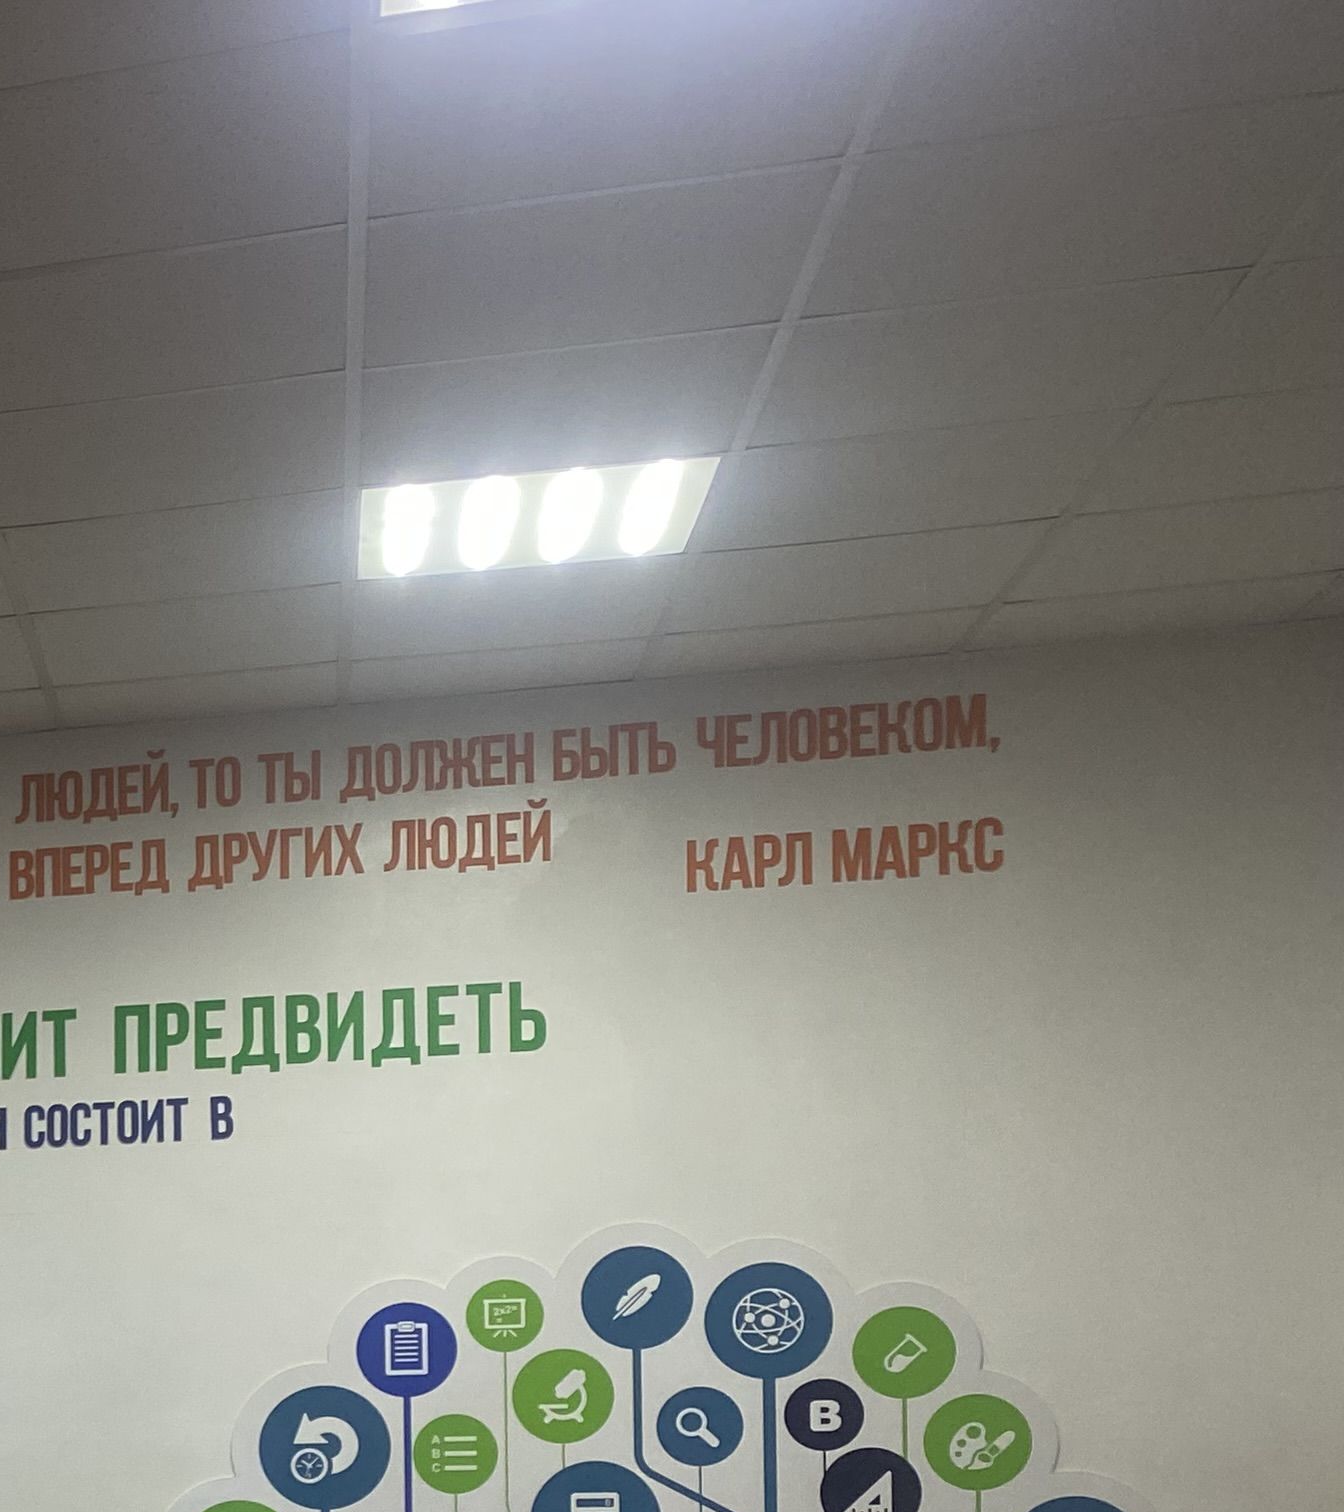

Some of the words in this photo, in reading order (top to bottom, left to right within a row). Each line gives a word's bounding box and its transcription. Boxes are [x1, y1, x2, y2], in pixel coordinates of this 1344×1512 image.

[14, 749, 180, 825] ЛЮДЕЙ,
[189, 756, 243, 809] ТО
[257, 750, 321, 805] ТЫ
[340, 731, 535, 804] ДОЛЖЕН
[552, 720, 677, 782] БЫТЬ
[696, 693, 1002, 768] ЧЕЛОВЕКОМ,
[9, 838, 170, 902] ВПЕРЕД
[186, 821, 365, 893] ДРУГИХ
[382, 797, 553, 874] ЛЮДЕЙ
[684, 831, 814, 894] КАРЛ
[831, 816, 1006, 884] МАРКС
[113, 980, 548, 1076] ПРЕДВИДЕТЬ
[24, 1098, 187, 1148] СОСТОИТ
[210, 1096, 235, 1140] В
